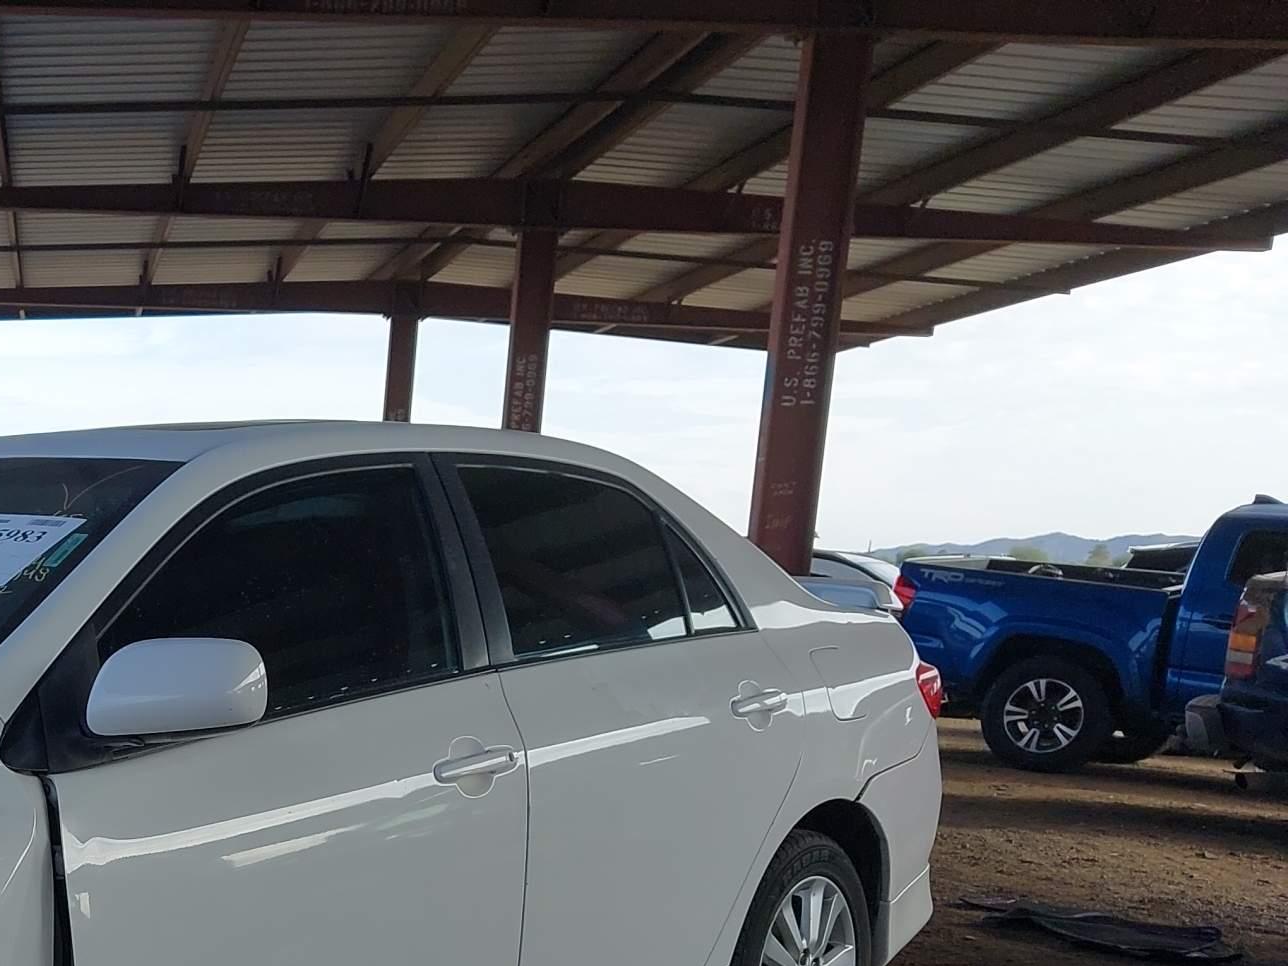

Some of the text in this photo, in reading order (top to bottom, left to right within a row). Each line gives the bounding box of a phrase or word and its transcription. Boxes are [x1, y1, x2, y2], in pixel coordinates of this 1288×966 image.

[781, 239, 816, 407] U.S. PREFAB INC.
[800, 240, 835, 405] 1-866-799-0969
[919, 567, 965, 584] TRD
